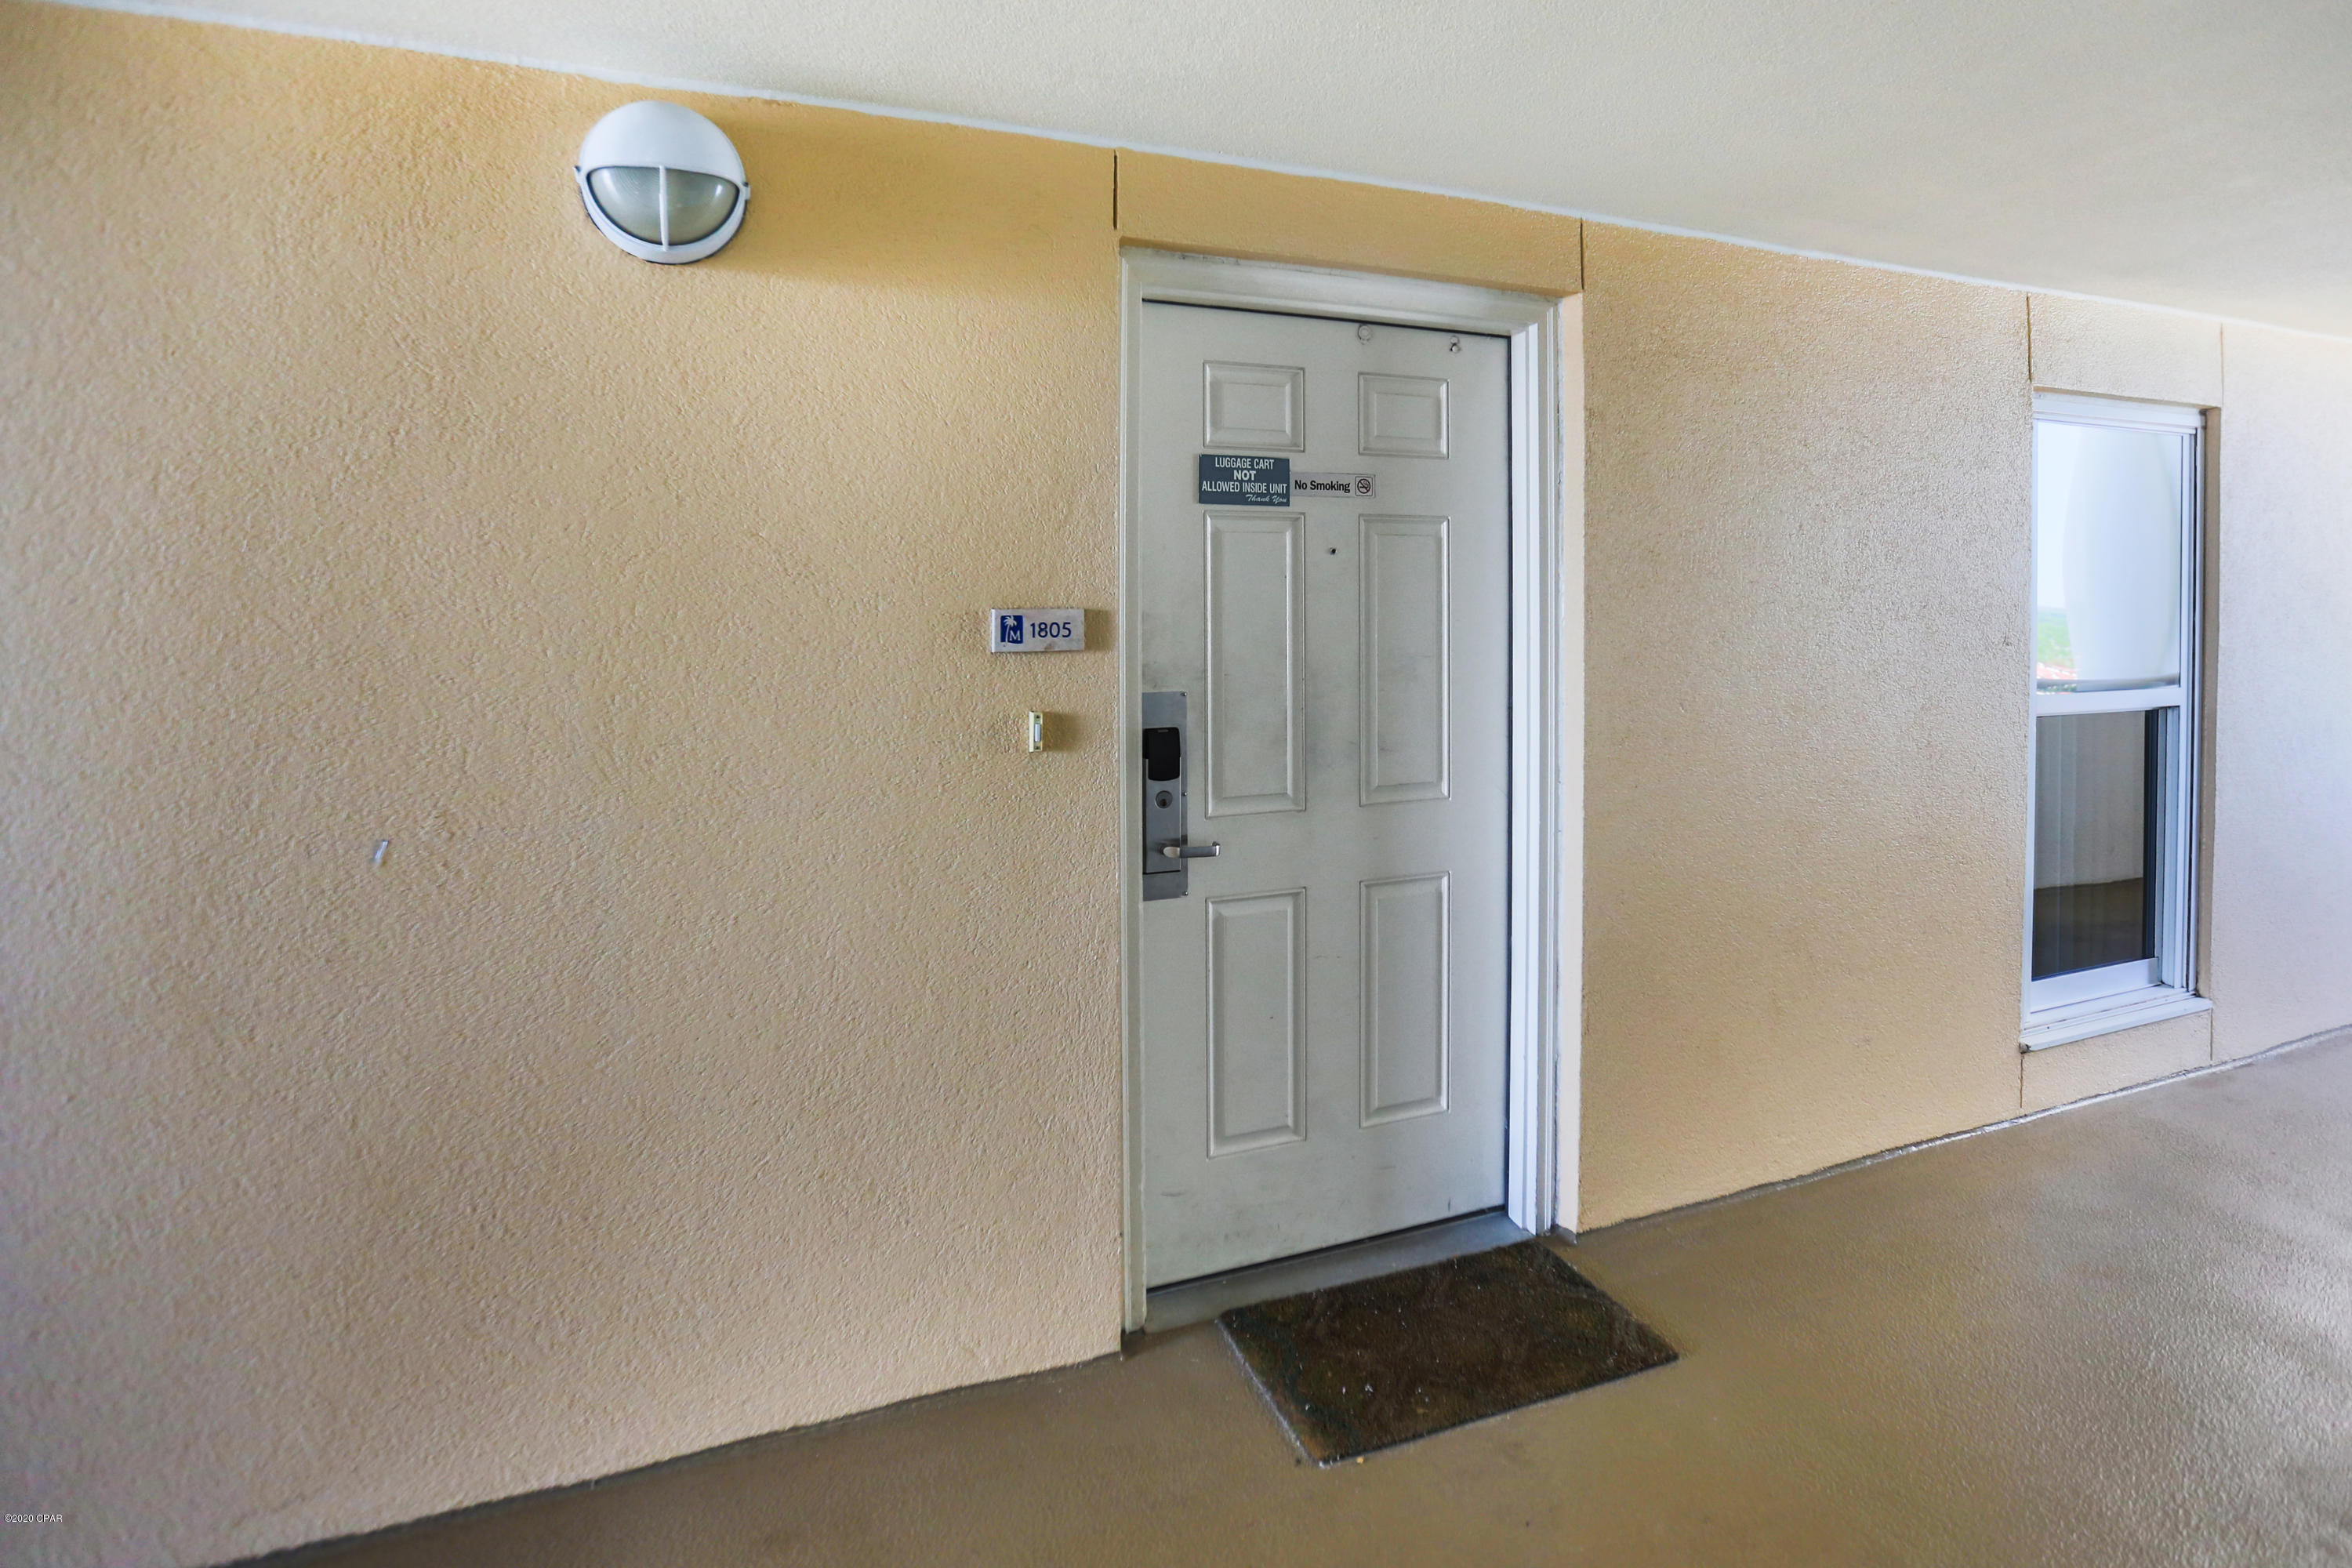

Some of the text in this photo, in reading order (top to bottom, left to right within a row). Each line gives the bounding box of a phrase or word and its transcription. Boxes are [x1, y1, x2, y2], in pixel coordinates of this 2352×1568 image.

[1215, 457, 1275, 470] LUGGAGE CART
[1233, 470, 1257, 481] NOT
[1201, 481, 1287, 494] ALLOWED INSIDE UNIT
[1294, 480, 1351, 494] No Smoking
[1245, 494, 1287, 504] Thank You
[1009, 630, 1021, 641] M
[1029, 622, 1072, 638] 1805
